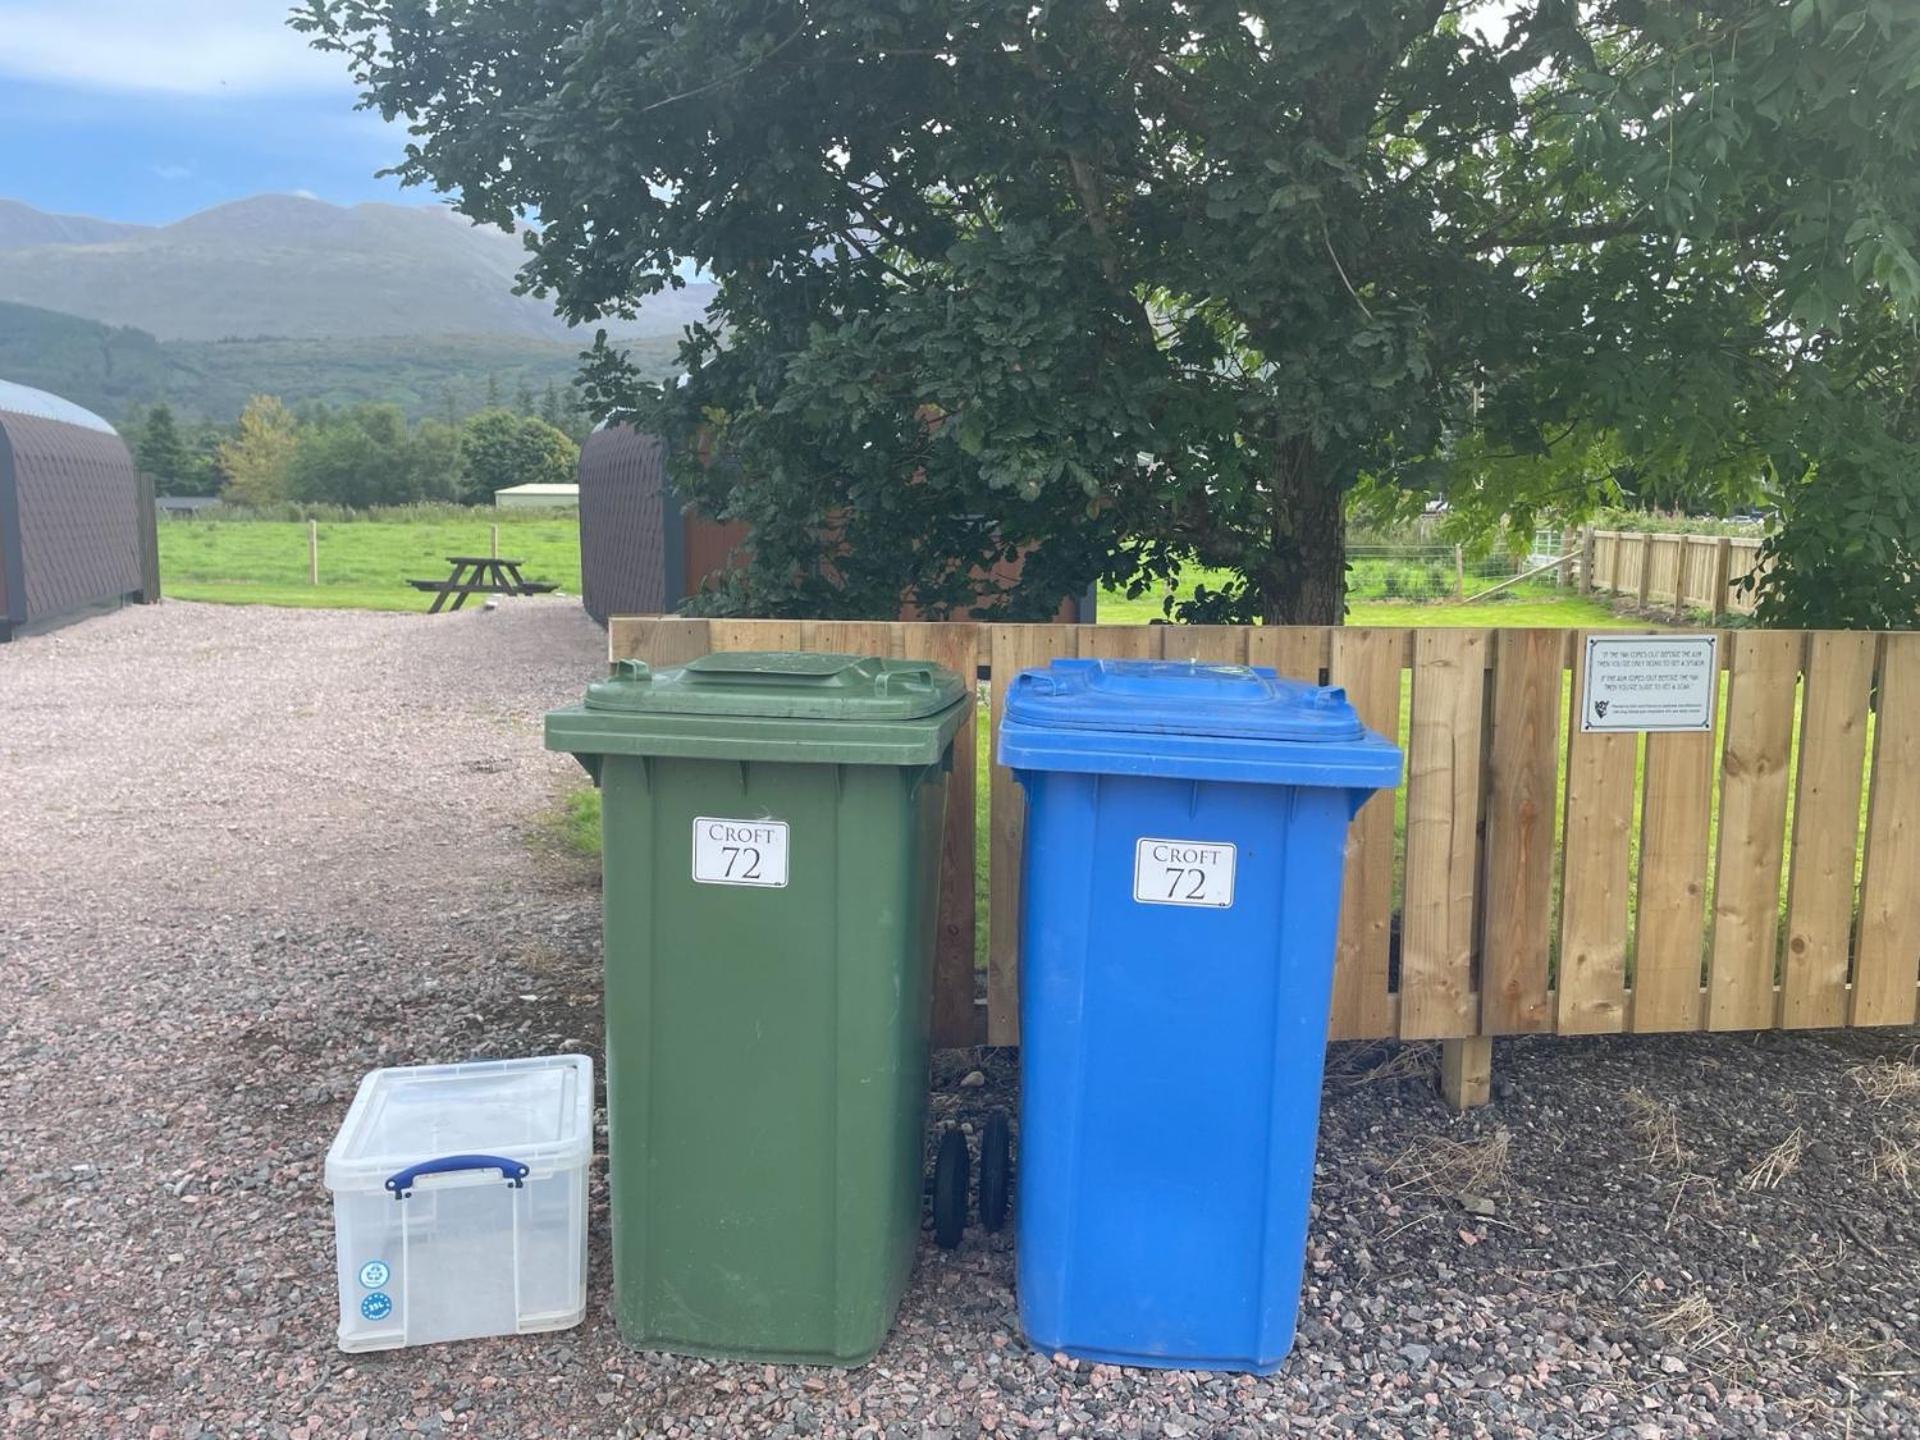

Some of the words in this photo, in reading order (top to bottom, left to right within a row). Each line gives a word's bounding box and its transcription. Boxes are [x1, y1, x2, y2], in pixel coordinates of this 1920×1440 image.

[709, 823, 775, 844] CROFT
[721, 846, 761, 879] 72
[1153, 845, 1221, 865] CROFT
[1166, 867, 1205, 900] 72
